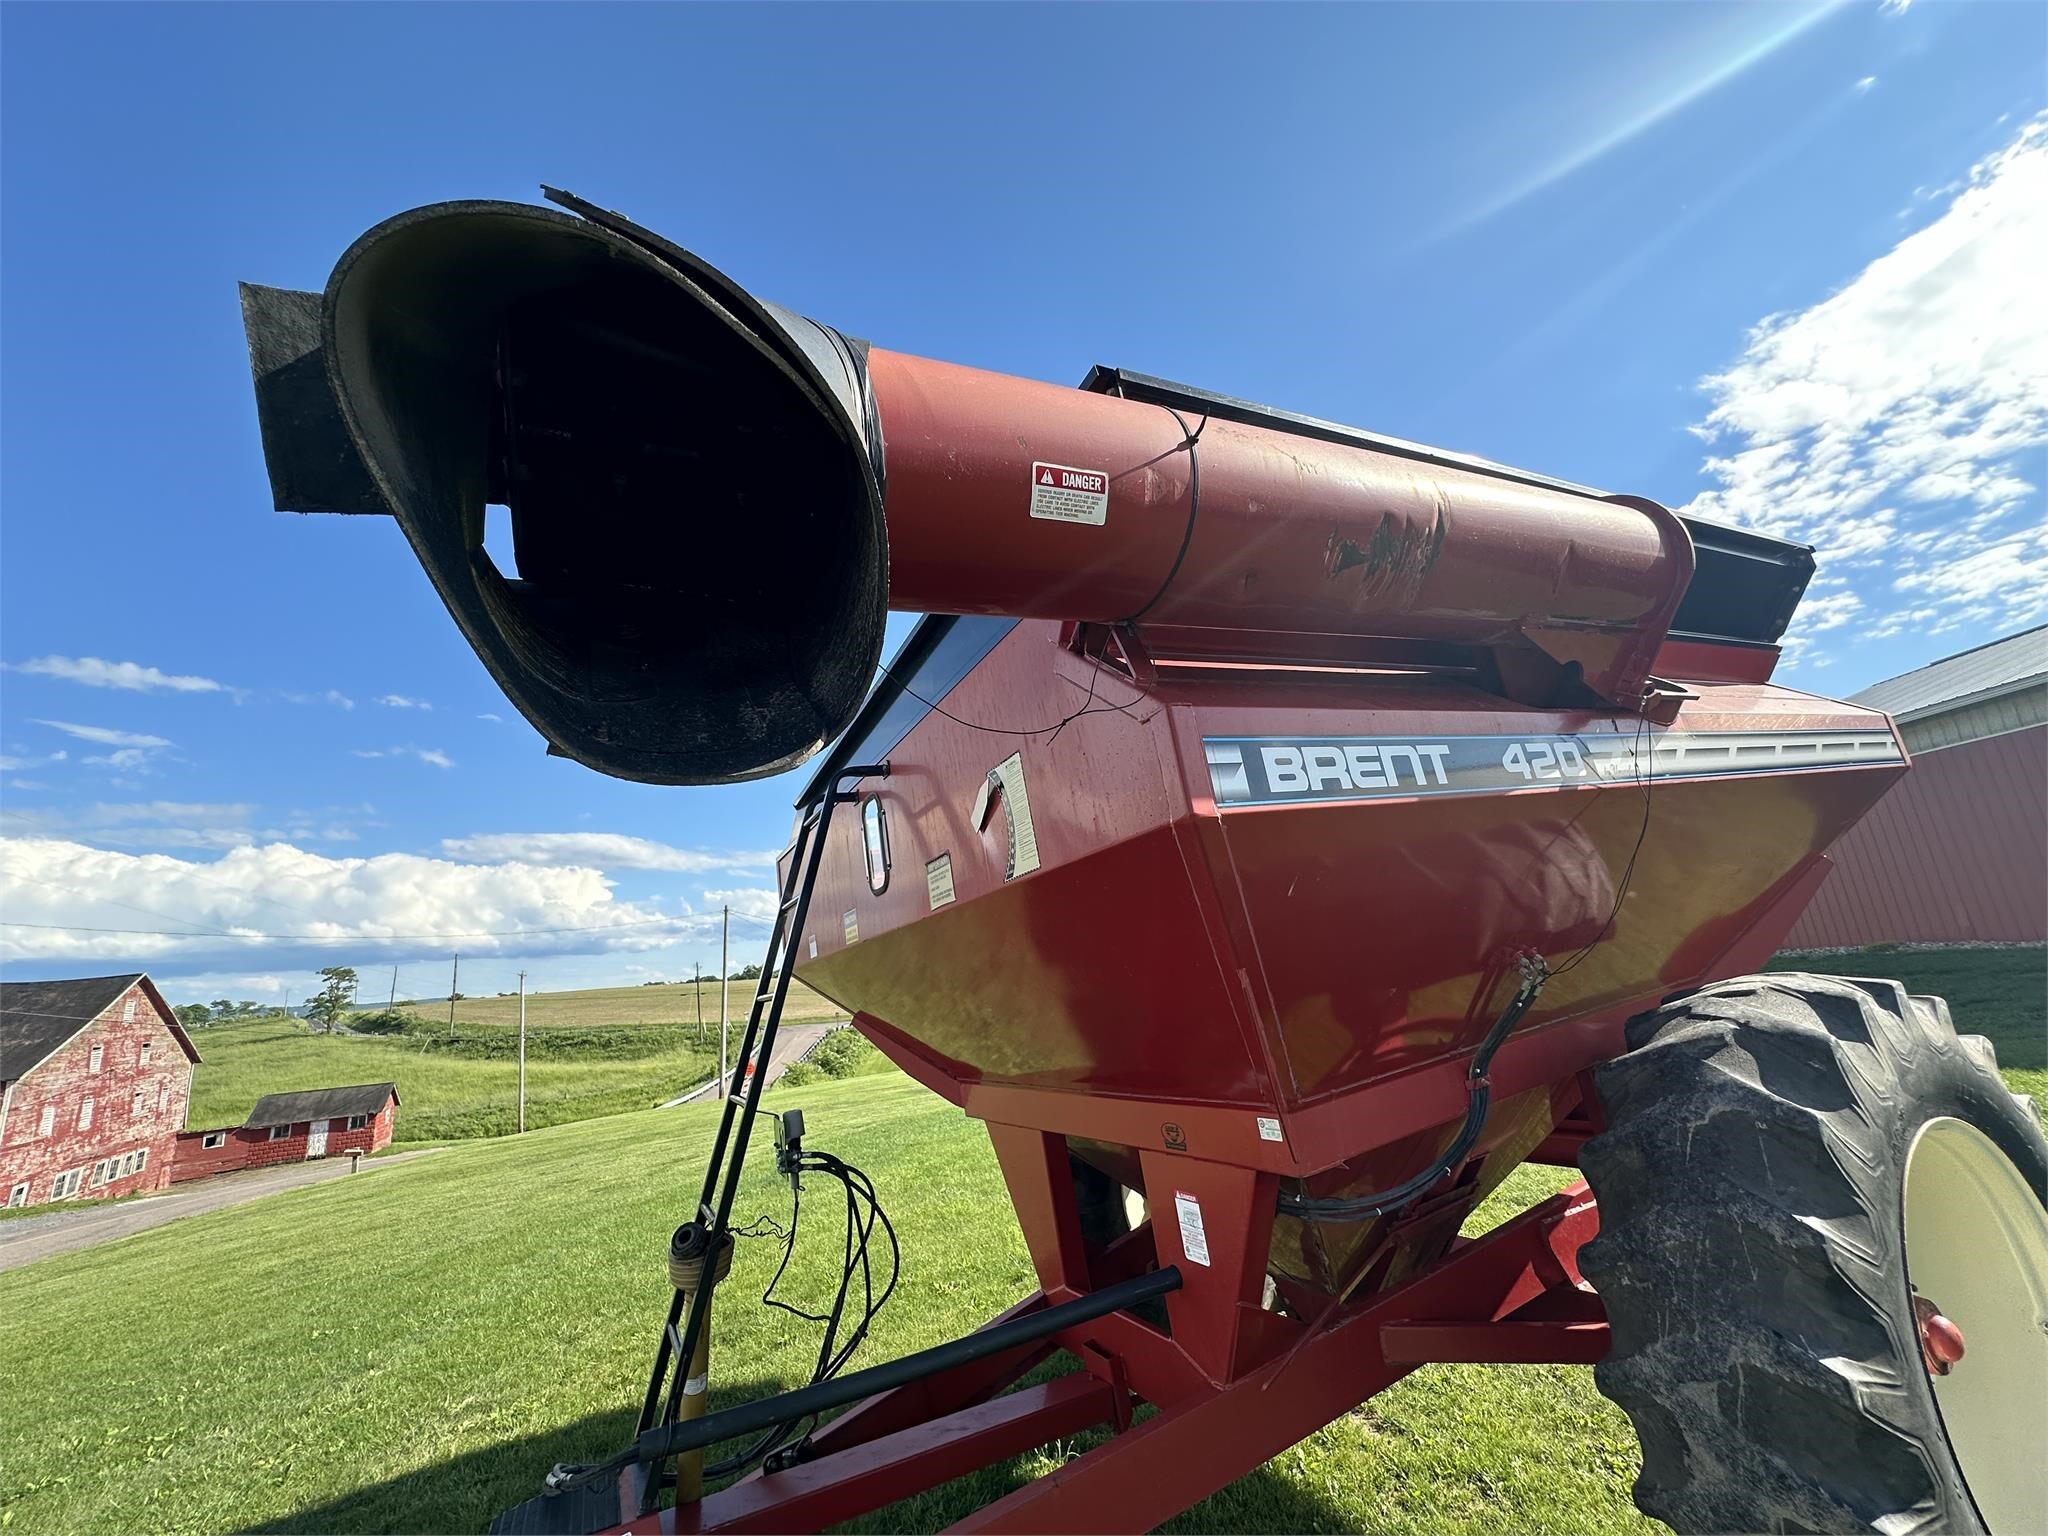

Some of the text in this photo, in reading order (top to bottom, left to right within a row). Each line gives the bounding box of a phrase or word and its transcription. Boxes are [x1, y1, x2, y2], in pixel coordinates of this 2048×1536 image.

[1062, 472, 1102, 491] DANGER
[1260, 742, 1587, 792] BRENT 420
